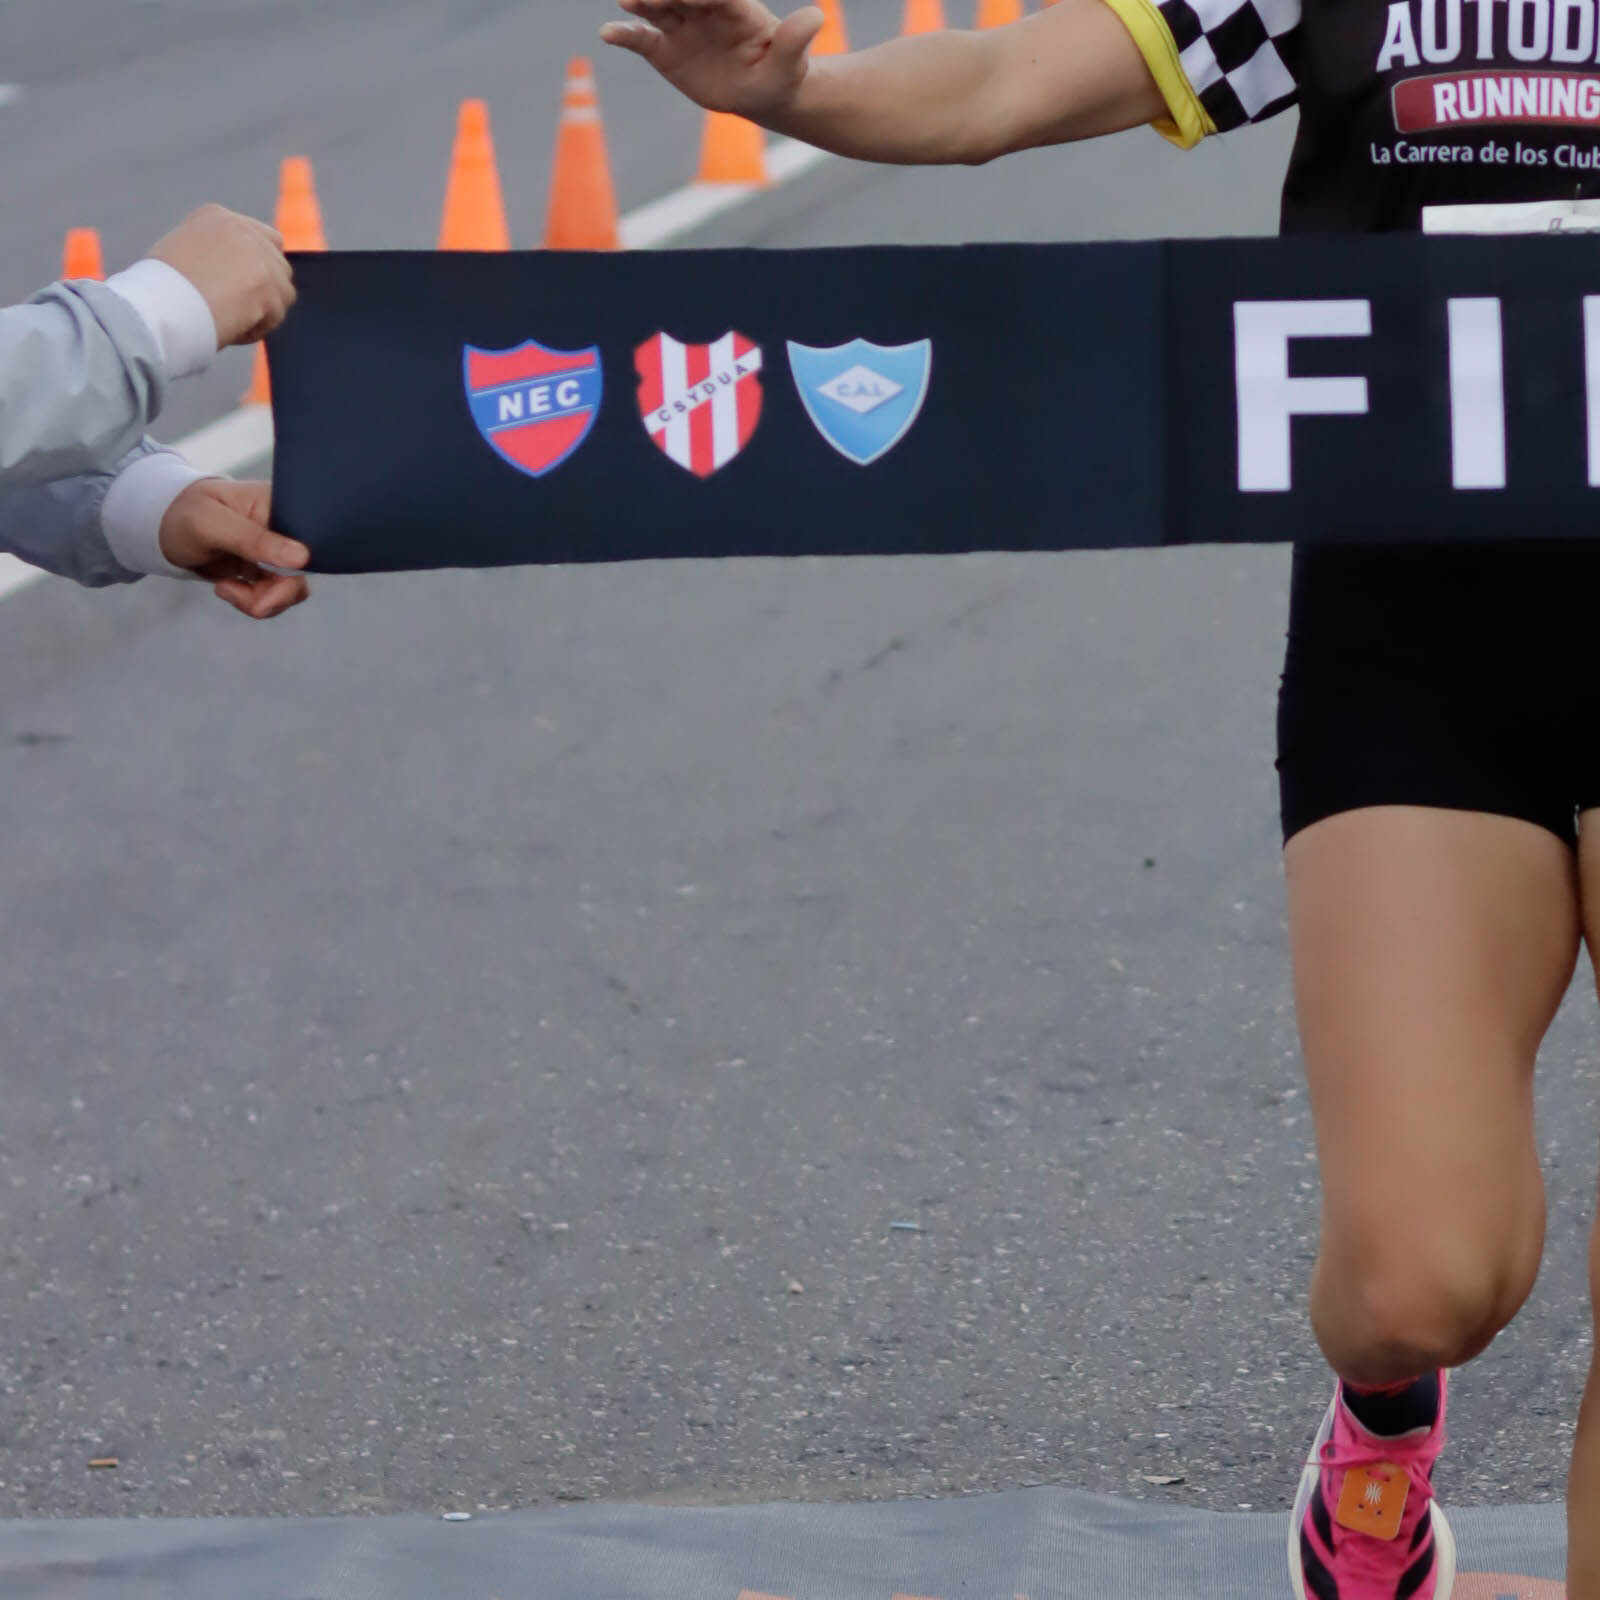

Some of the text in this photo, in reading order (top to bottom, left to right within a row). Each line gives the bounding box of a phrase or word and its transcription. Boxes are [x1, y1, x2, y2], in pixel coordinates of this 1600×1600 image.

[1371, 142, 1391, 165] La
[1394, 141, 1474, 164] Carrera
[1479, 141, 1510, 165] de
[1514, 141, 1548, 167] los
[498, 379, 581, 423] NEC
